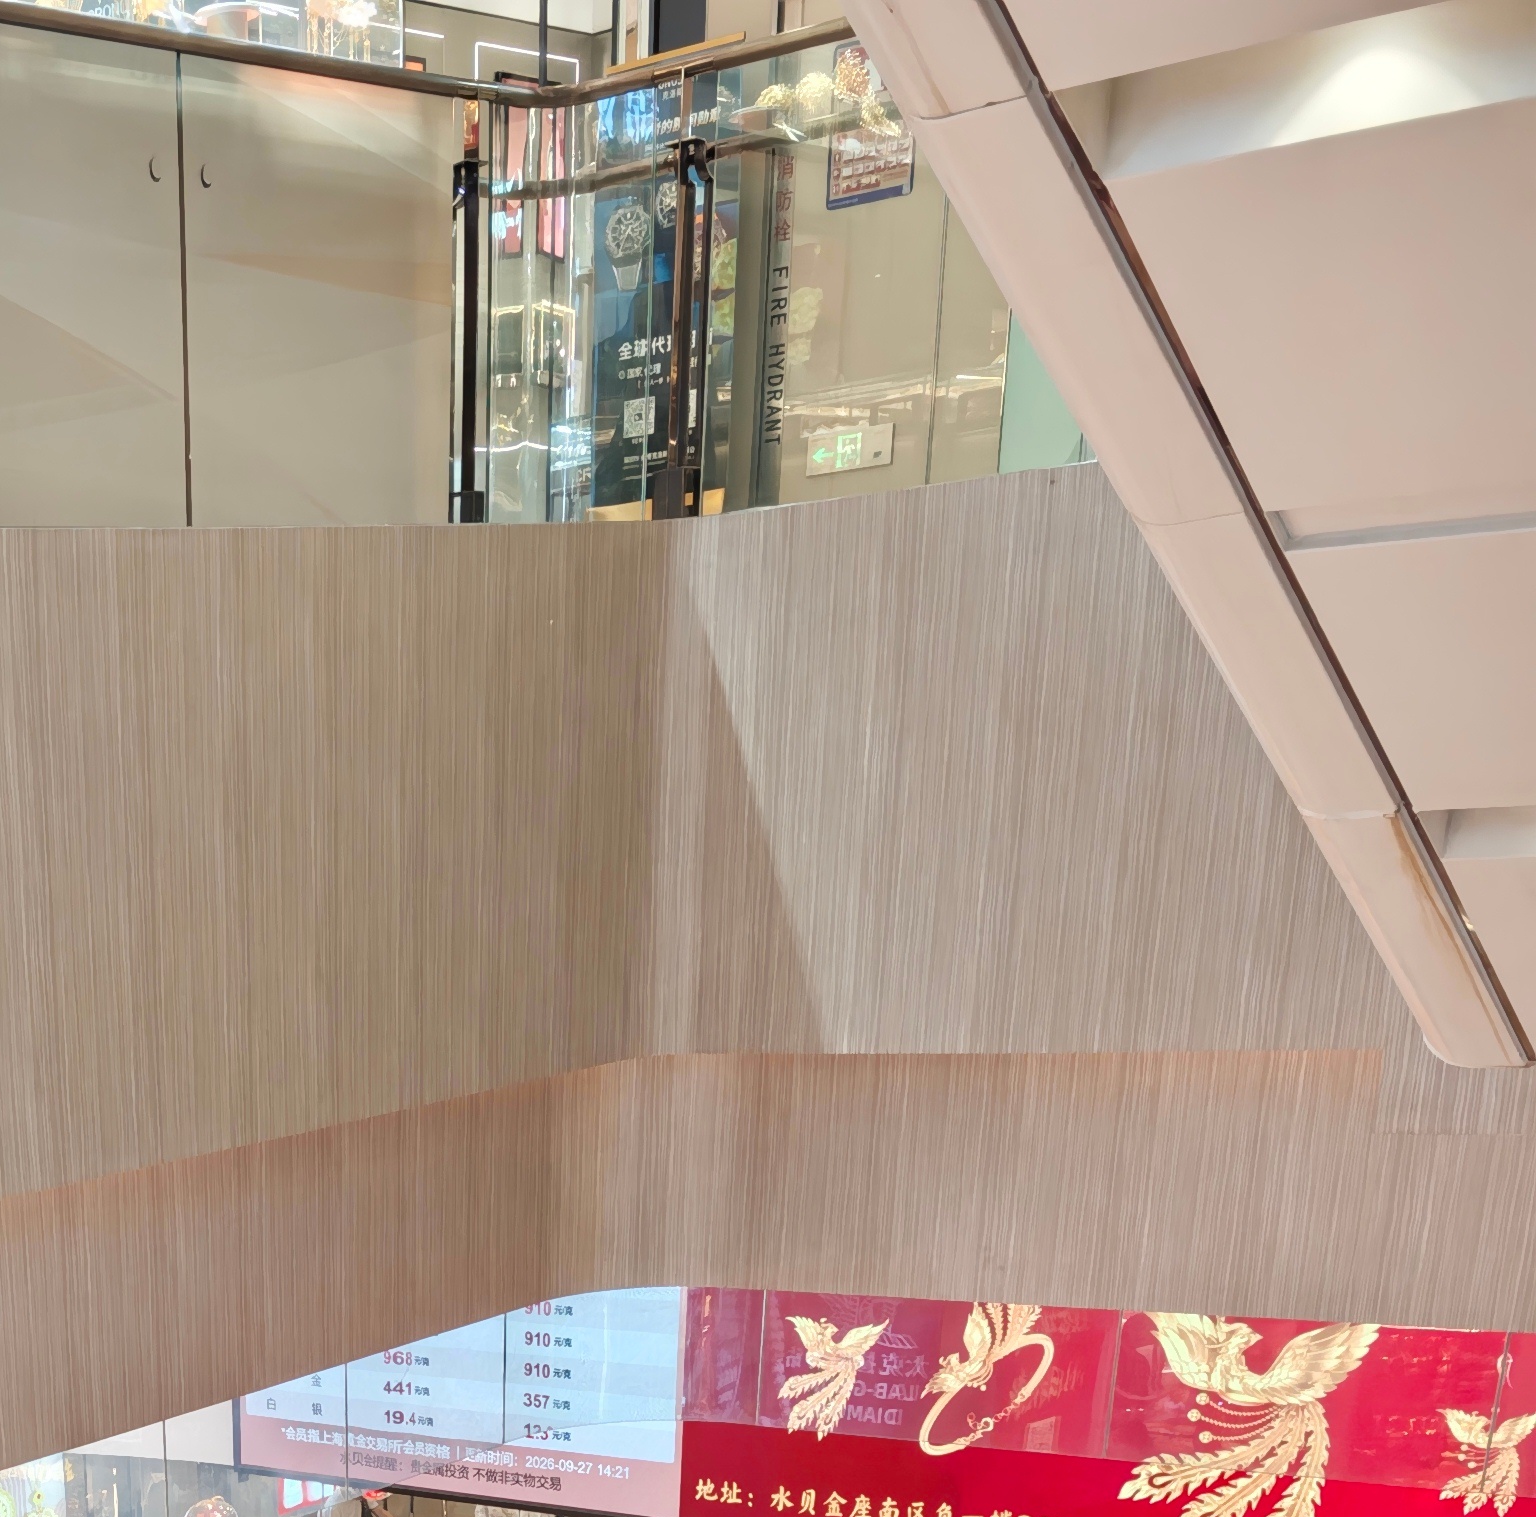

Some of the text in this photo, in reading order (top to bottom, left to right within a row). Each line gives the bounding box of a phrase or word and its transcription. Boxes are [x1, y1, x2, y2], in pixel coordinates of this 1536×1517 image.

[774, 155, 795, 242] 消防栓
[764, 265, 789, 446] FIRE HYDRANT
[554, 1305, 573, 1317] 元/克
[525, 1331, 572, 1348] 910 元/克
[383, 1350, 412, 1366] 968
[524, 1362, 550, 1379] 910
[553, 1368, 571, 1379] 元/克
[311, 1374, 322, 1387] 金
[383, 1380, 412, 1396] 441
[523, 1393, 550, 1409] 357
[552, 1399, 570, 1411] 元/克
[311, 1402, 323, 1416] 银
[384, 1409, 416, 1426] 19.4
[552, 1431, 572, 1442] 元/克
[473, 1468, 562, 1492] 不做非实物交易
[597, 1463, 630, 1480] 14:21
